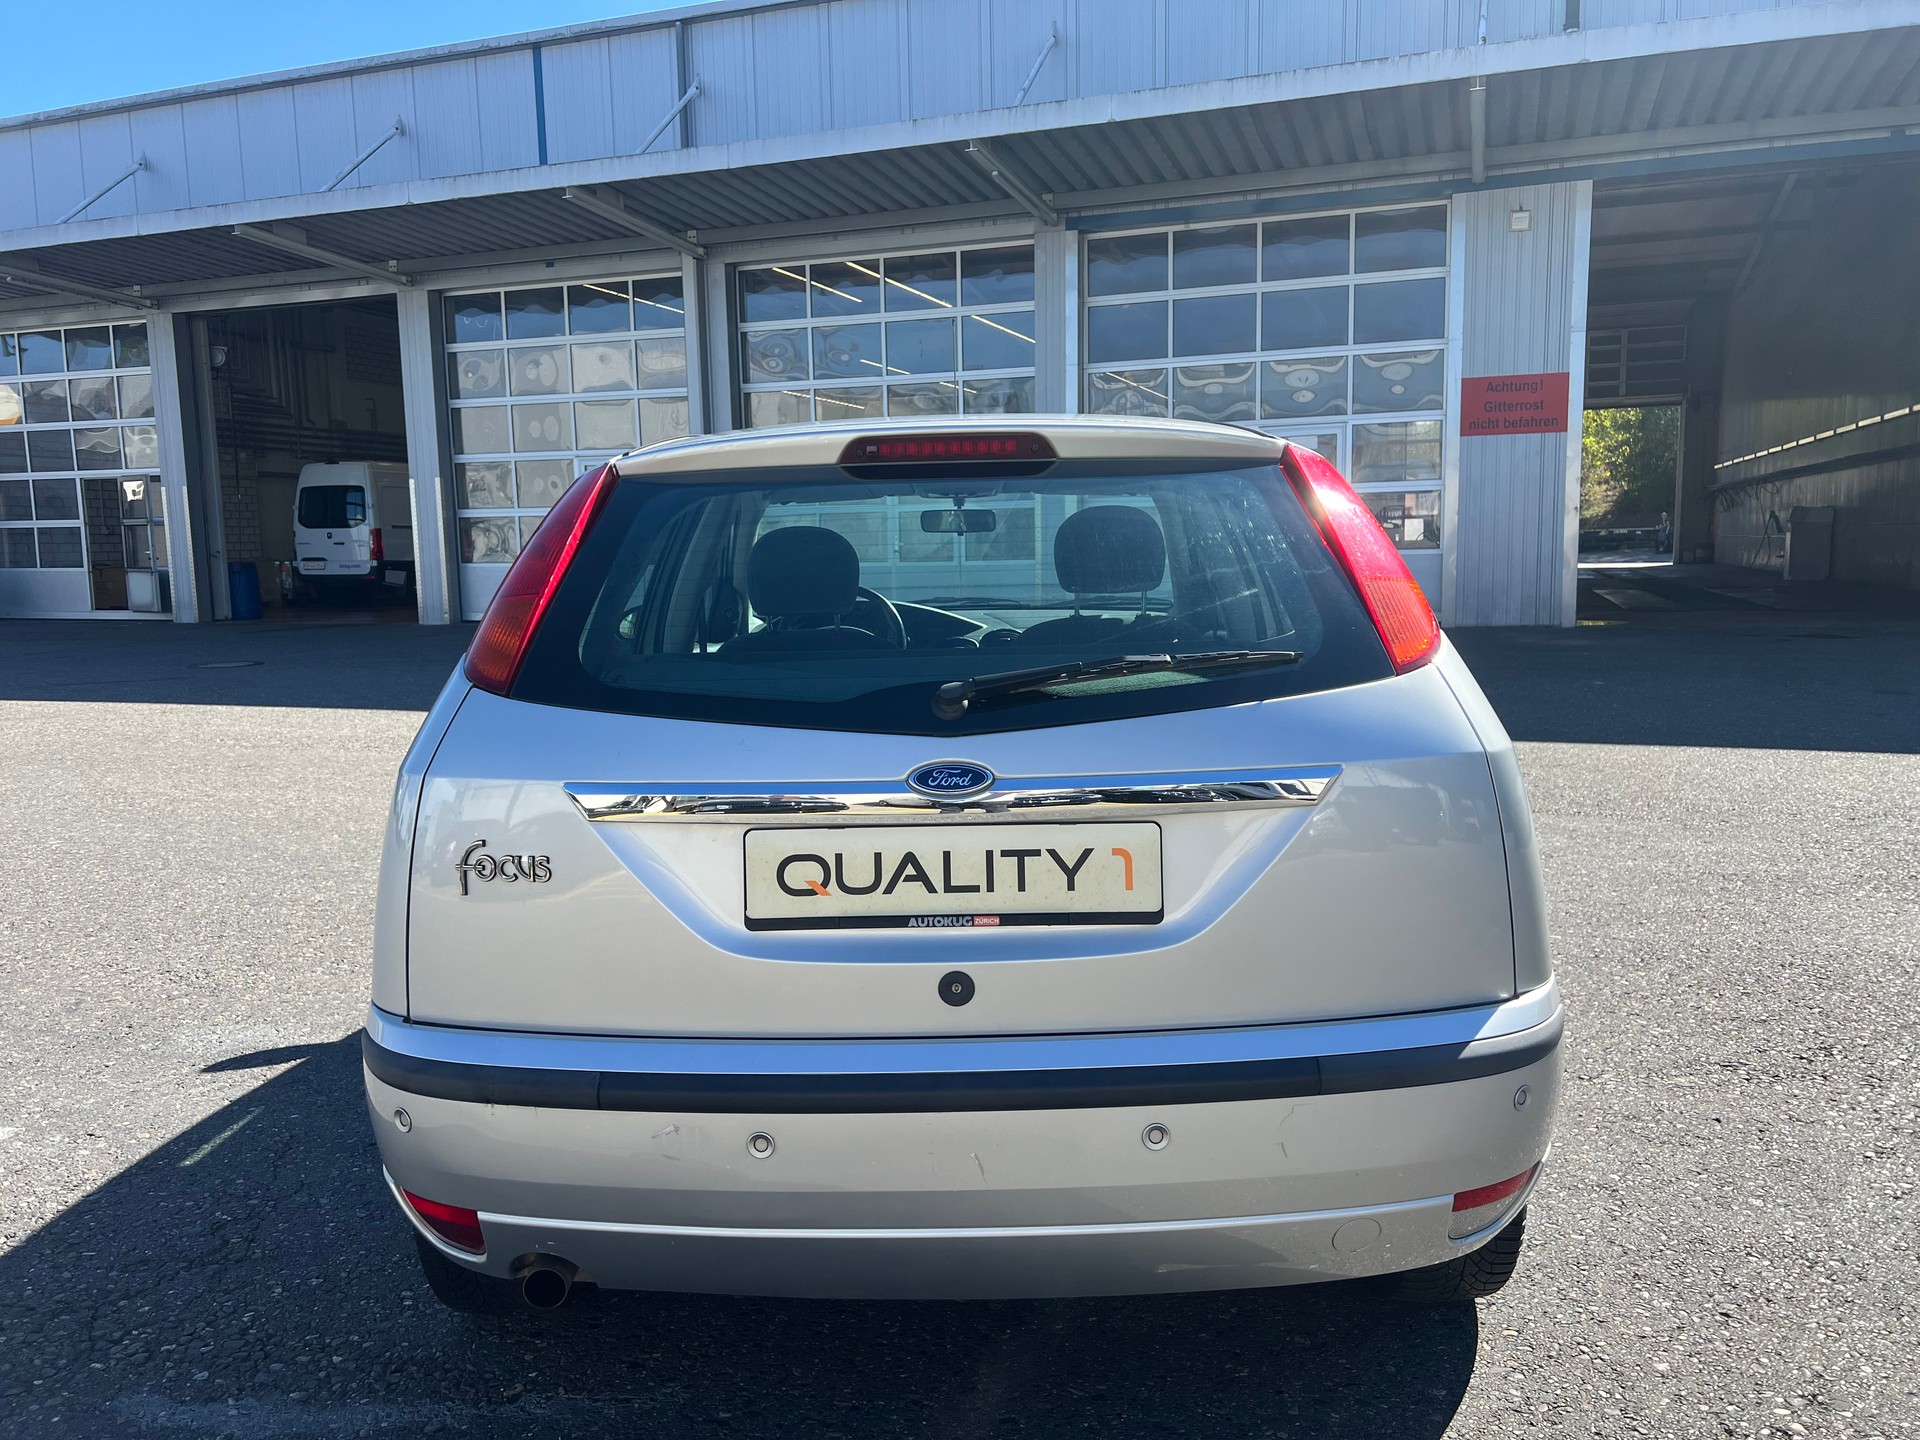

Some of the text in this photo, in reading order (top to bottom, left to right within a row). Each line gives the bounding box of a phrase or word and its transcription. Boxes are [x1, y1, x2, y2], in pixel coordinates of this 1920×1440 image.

[1486, 379, 1543, 393] Achtung!
[1484, 400, 1544, 412] Gitterrost
[1469, 416, 1559, 430] nicht befahren
[928, 769, 972, 786] Ford
[776, 848, 1134, 897] QUALITY 1
[908, 916, 973, 927] AUTOKUG
